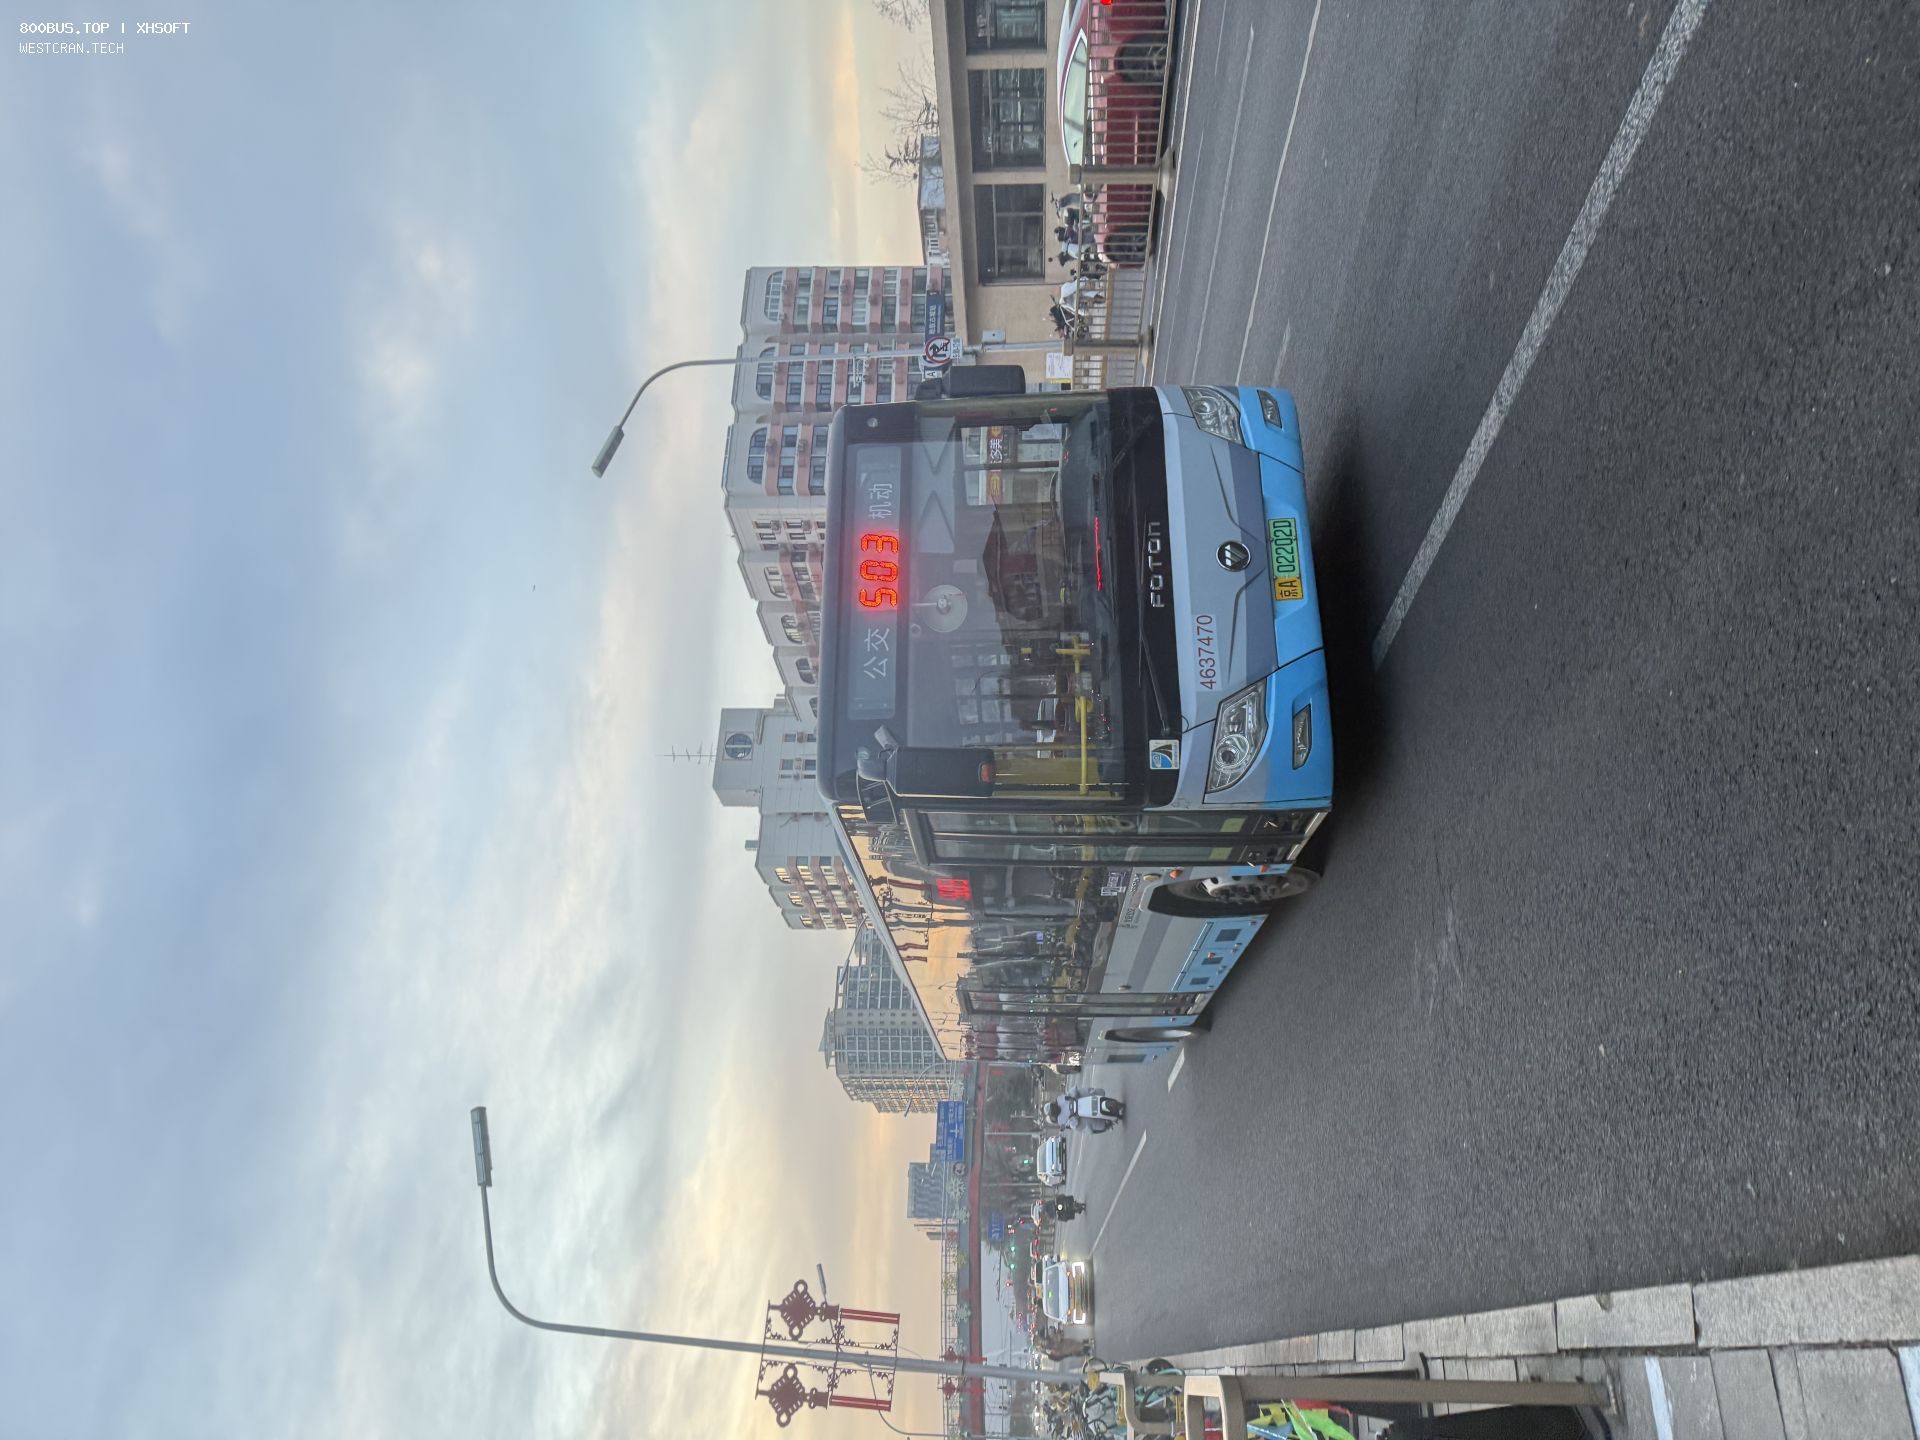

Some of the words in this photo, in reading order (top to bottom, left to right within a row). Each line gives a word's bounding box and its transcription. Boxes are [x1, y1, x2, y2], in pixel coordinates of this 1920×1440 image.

[867, 483, 893, 520] 机动
[858, 533, 898, 608] 503
[863, 627, 890, 679] 公交
[1196, 614, 1217, 690] 4637470
